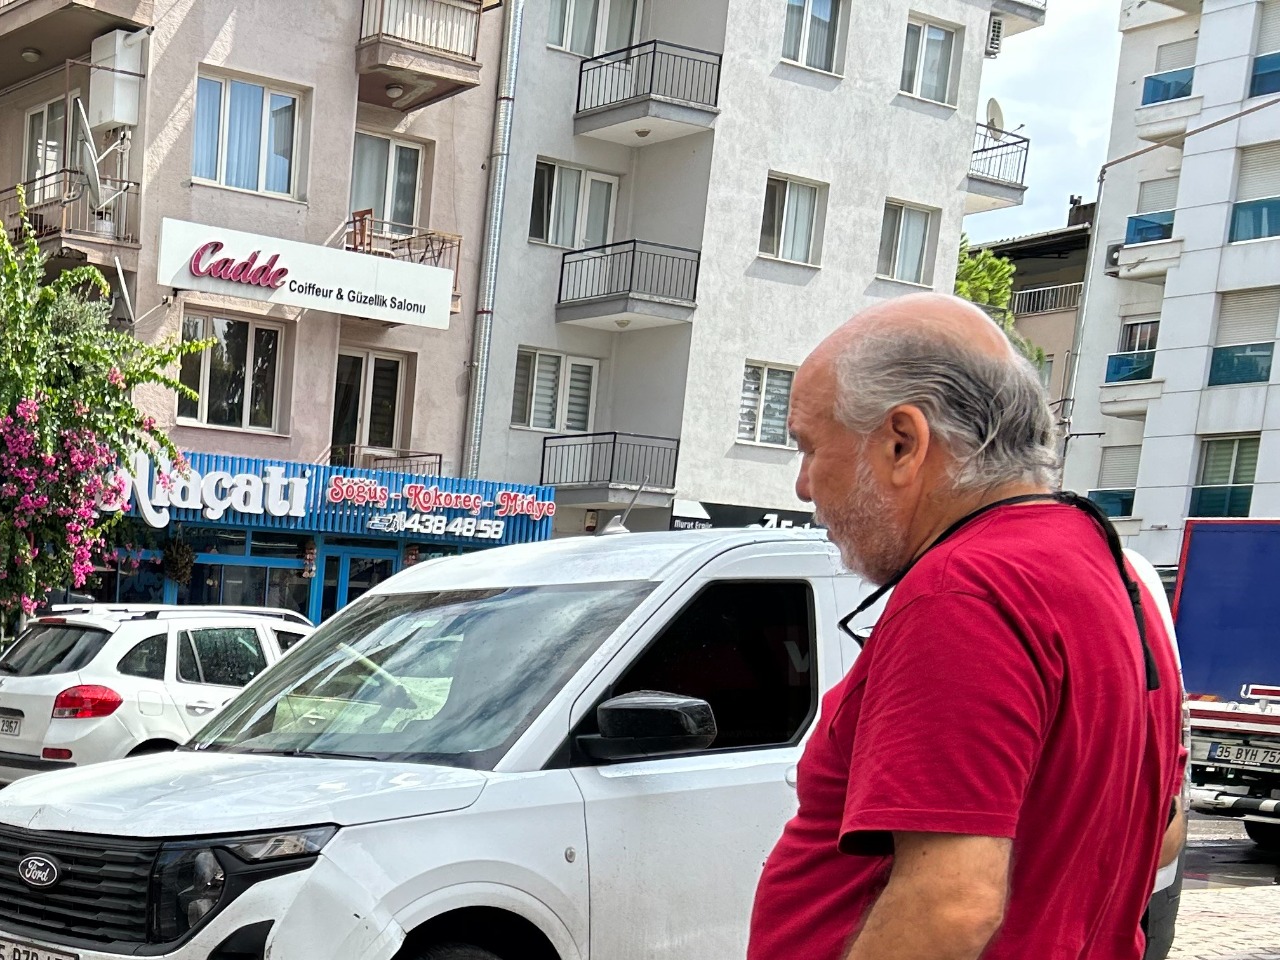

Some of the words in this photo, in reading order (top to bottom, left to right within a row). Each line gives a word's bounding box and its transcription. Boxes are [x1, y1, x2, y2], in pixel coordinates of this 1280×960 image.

[191, 241, 288, 290] Cadde
[289, 279, 333, 299] Coiffeur
[336, 288, 345, 301] &
[347, 289, 388, 310] Güzellik
[389, 294, 426, 314] Salonu
[327, 475, 388, 508] Söğüş
[407, 484, 483, 515] Kokoreç
[496, 491, 556, 520] Midye
[1216, 746, 1231, 758] 35
[1235, 748, 1259, 761] BYH
[25, 859, 49, 882] Ford
